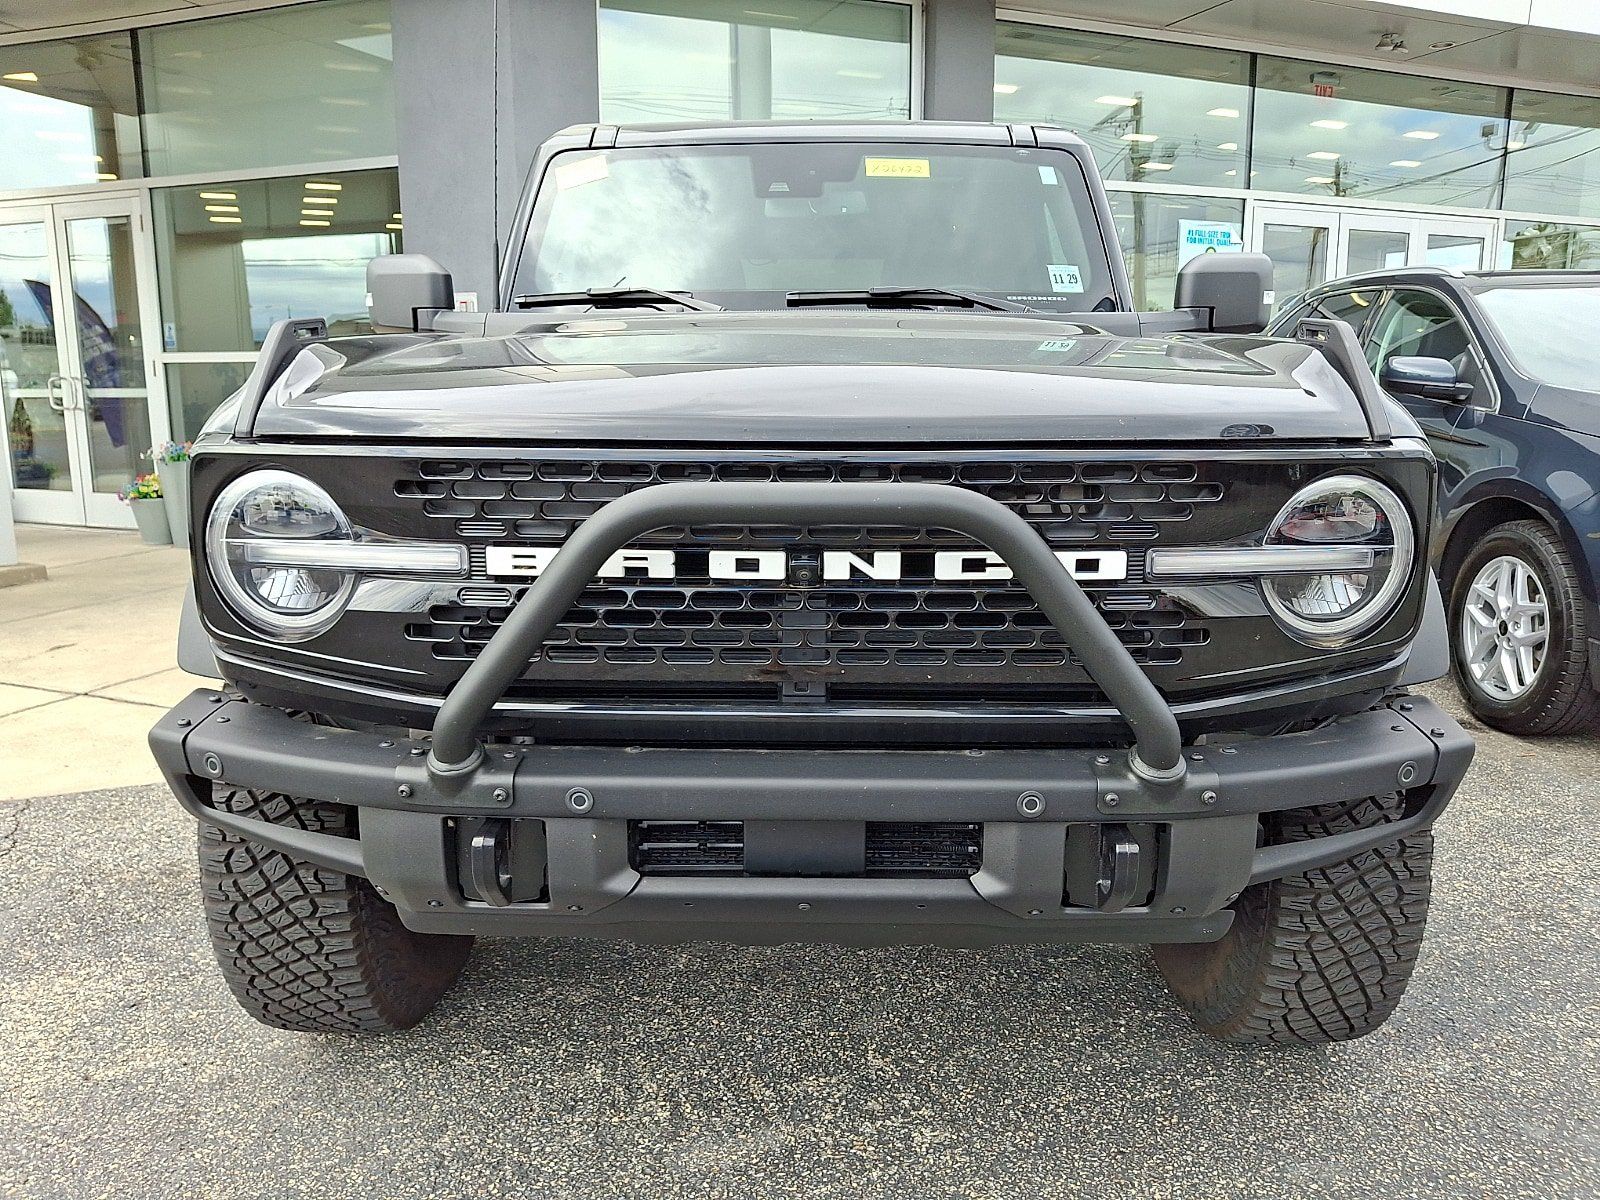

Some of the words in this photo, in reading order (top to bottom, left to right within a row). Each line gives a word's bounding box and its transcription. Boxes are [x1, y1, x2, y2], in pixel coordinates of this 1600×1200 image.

[1053, 273, 1064, 284] 11
[1067, 273, 1078, 284] 29
[486, 546, 1128, 580] BRONCO
